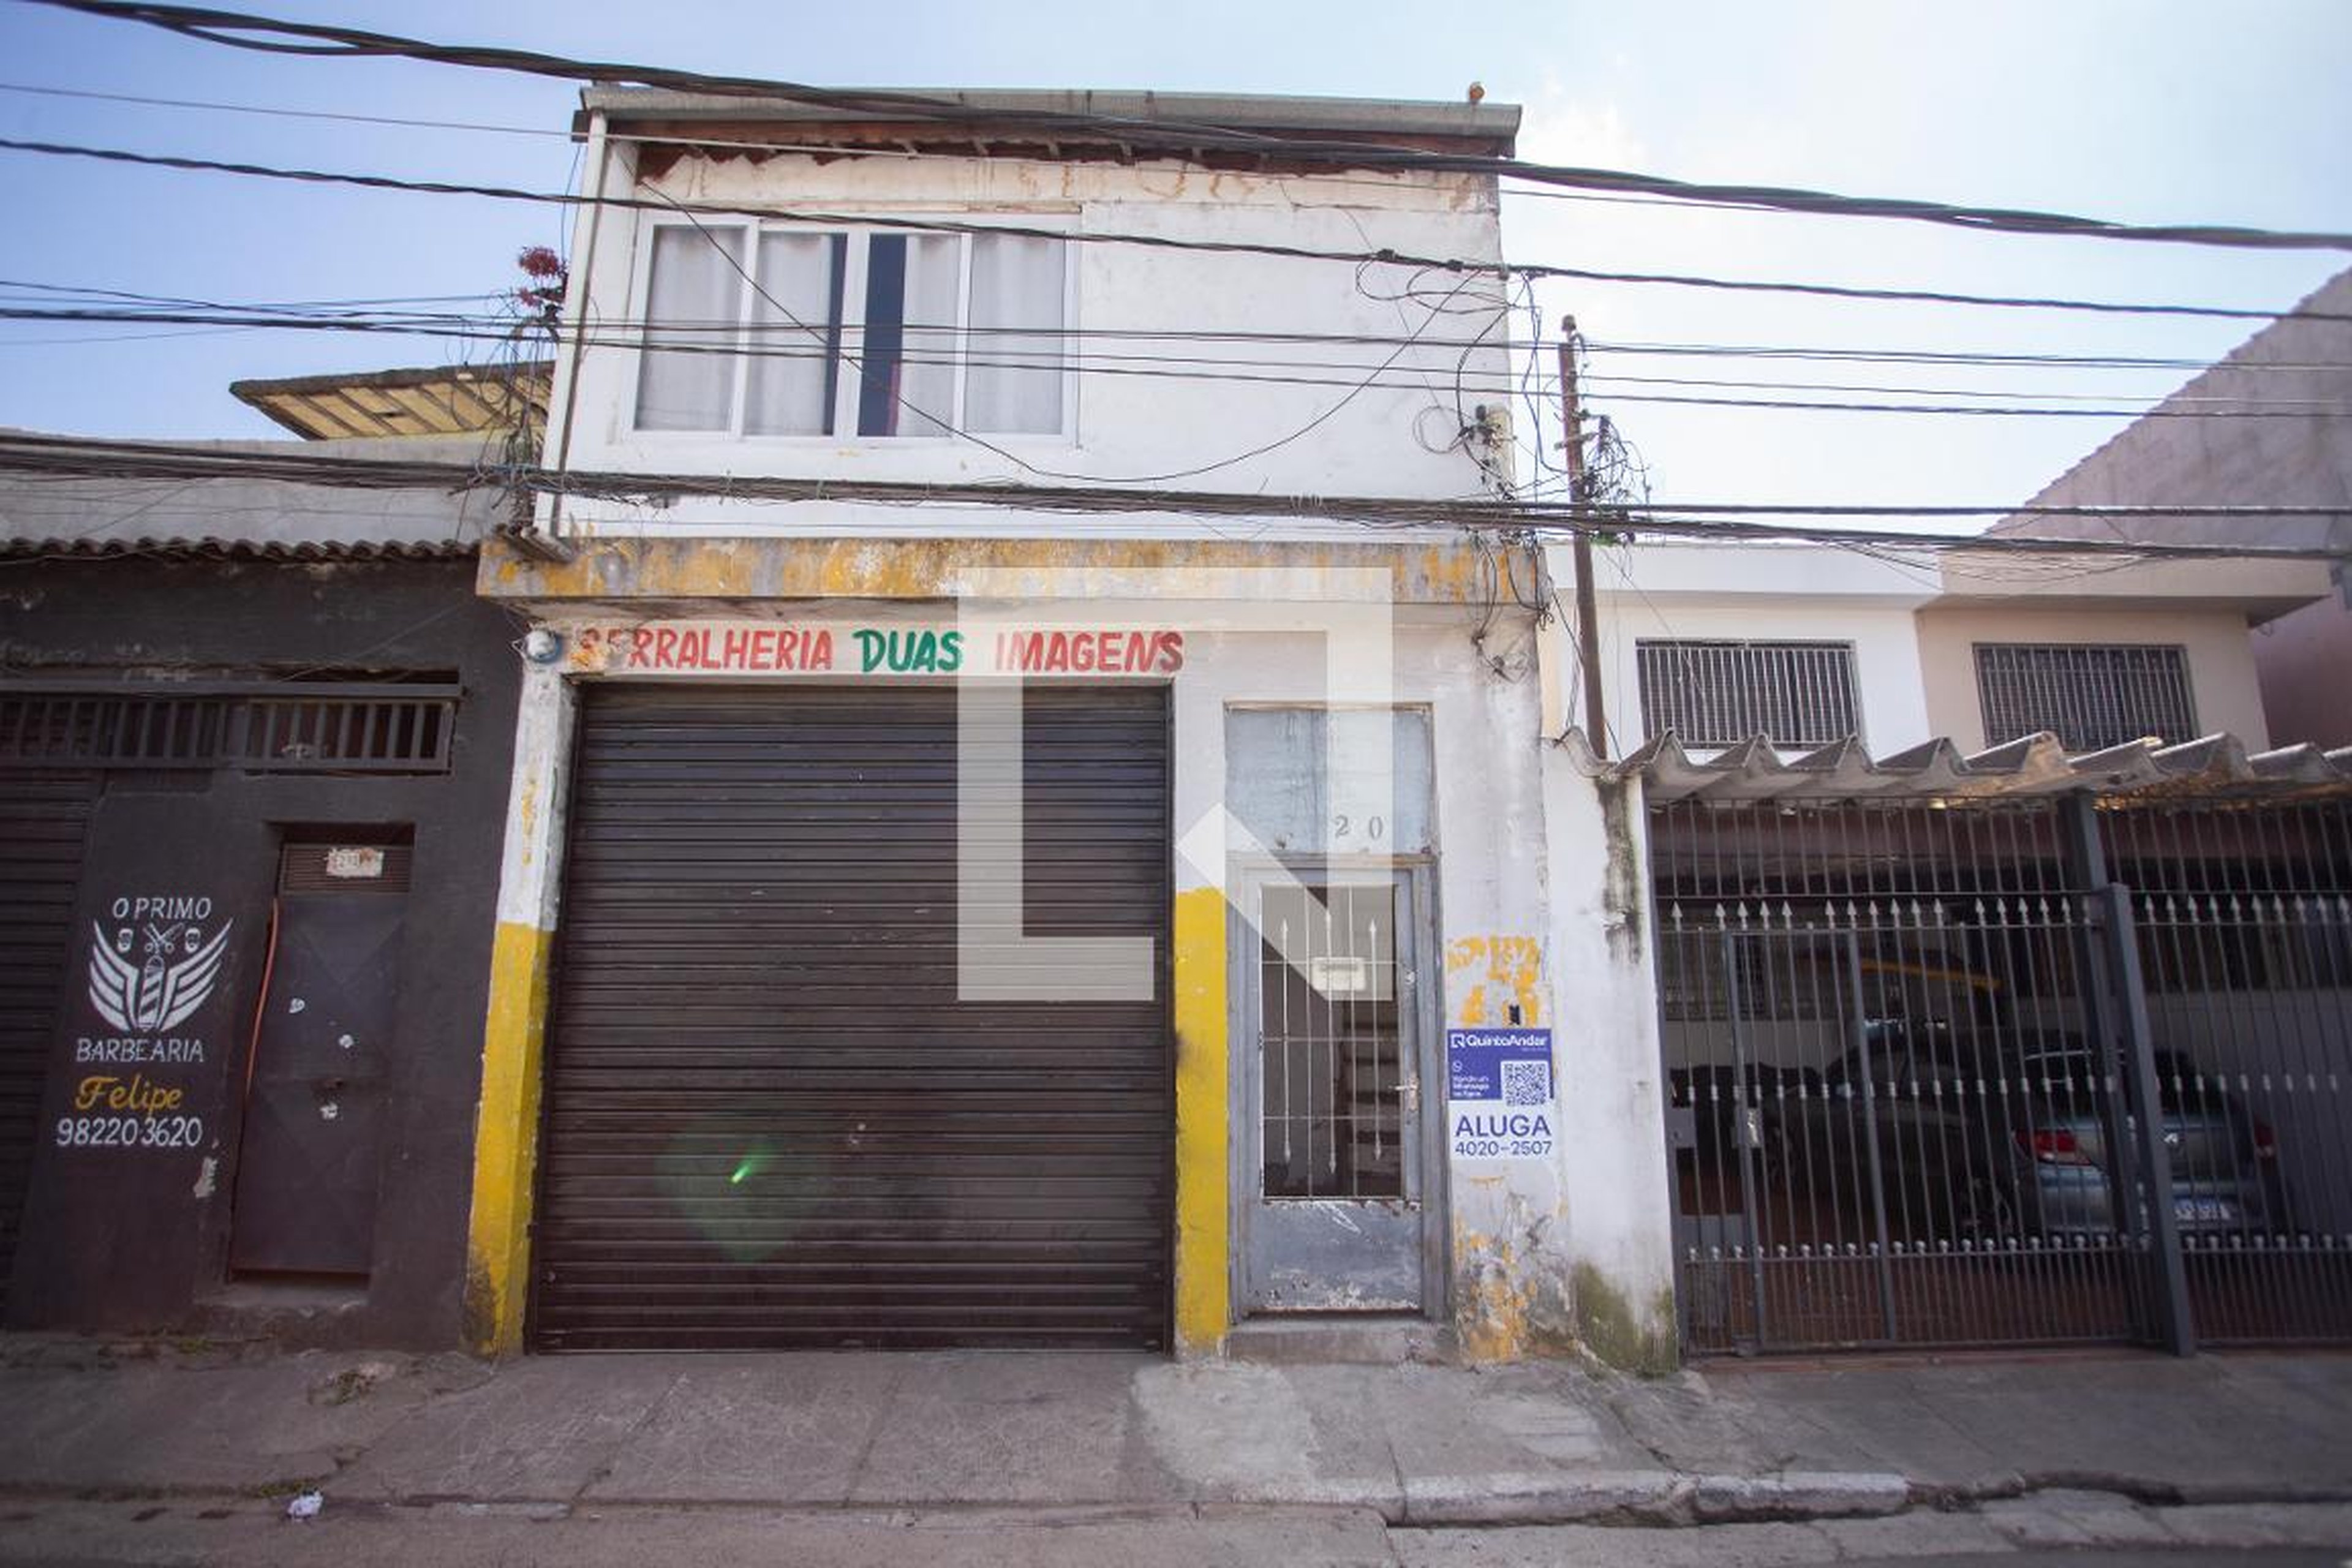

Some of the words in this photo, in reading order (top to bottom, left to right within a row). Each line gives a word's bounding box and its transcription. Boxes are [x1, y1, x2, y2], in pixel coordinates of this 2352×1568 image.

[852, 629, 963, 673] DUAS
[995, 630, 1183, 673] IMAGENS
[113, 897, 129, 919] O
[134, 897, 212, 919] PRIMO
[76, 1038, 204, 1062] BARBEARIA
[75, 1074, 183, 1117] Felipe
[1456, 1115, 1551, 1137] ALUGA
[1455, 1140, 1552, 1155] 4020-2507
